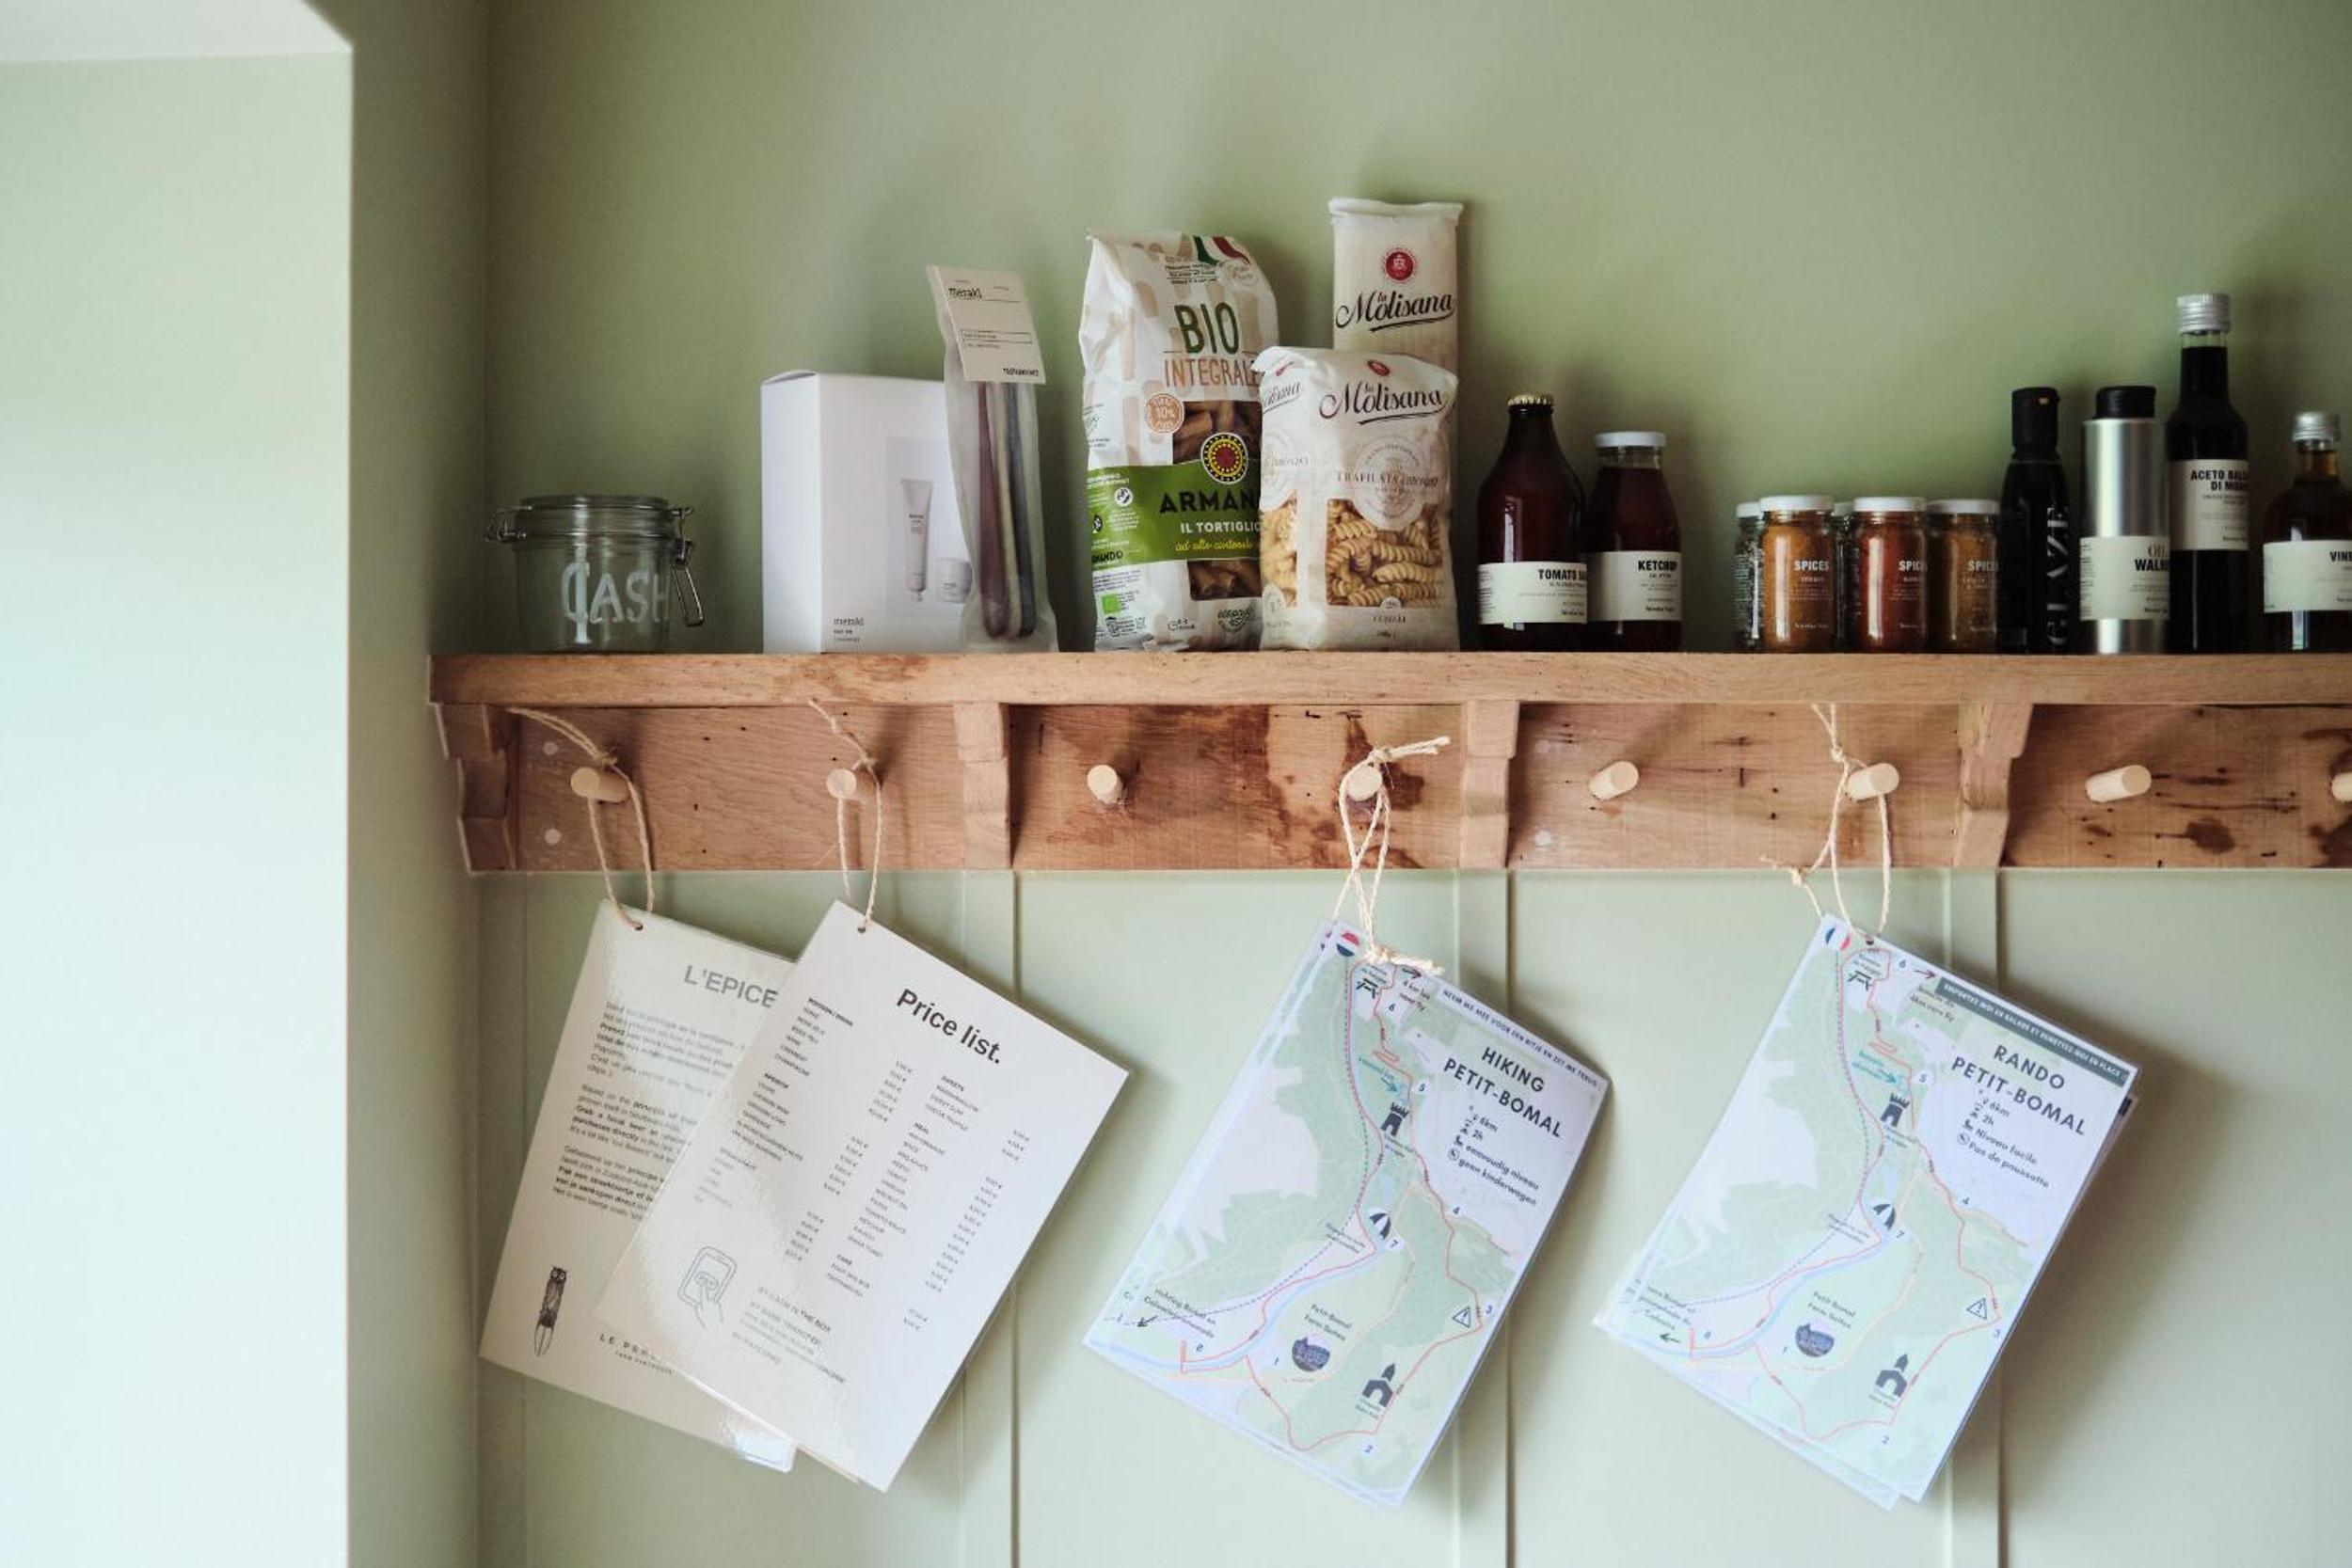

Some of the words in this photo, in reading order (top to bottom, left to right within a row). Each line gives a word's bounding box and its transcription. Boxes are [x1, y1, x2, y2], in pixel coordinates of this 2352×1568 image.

[1174, 301, 1239, 354] BIO
[1336, 291, 1455, 328] Molisana
[1319, 381, 1445, 420] Molisana
[1181, 522, 1193, 534] IL
[562, 562, 670, 624] CASH
[684, 965, 779, 1008] L'EPICE
[896, 988, 958, 1037] Price
[959, 1024, 1001, 1064] list.
[1481, 1047, 1546, 1092] HIKING
[1994, 1044, 2065, 1089] RANDO
[1442, 1058, 1563, 1138] PETIT-BOMAL
[1950, 1056, 2086, 1136] PETIT-BOMAL
[1988, 1101, 2010, 1117] 6km
[1980, 1114, 1995, 1127] 2h
[2001, 1158, 2050, 1189] poussette
